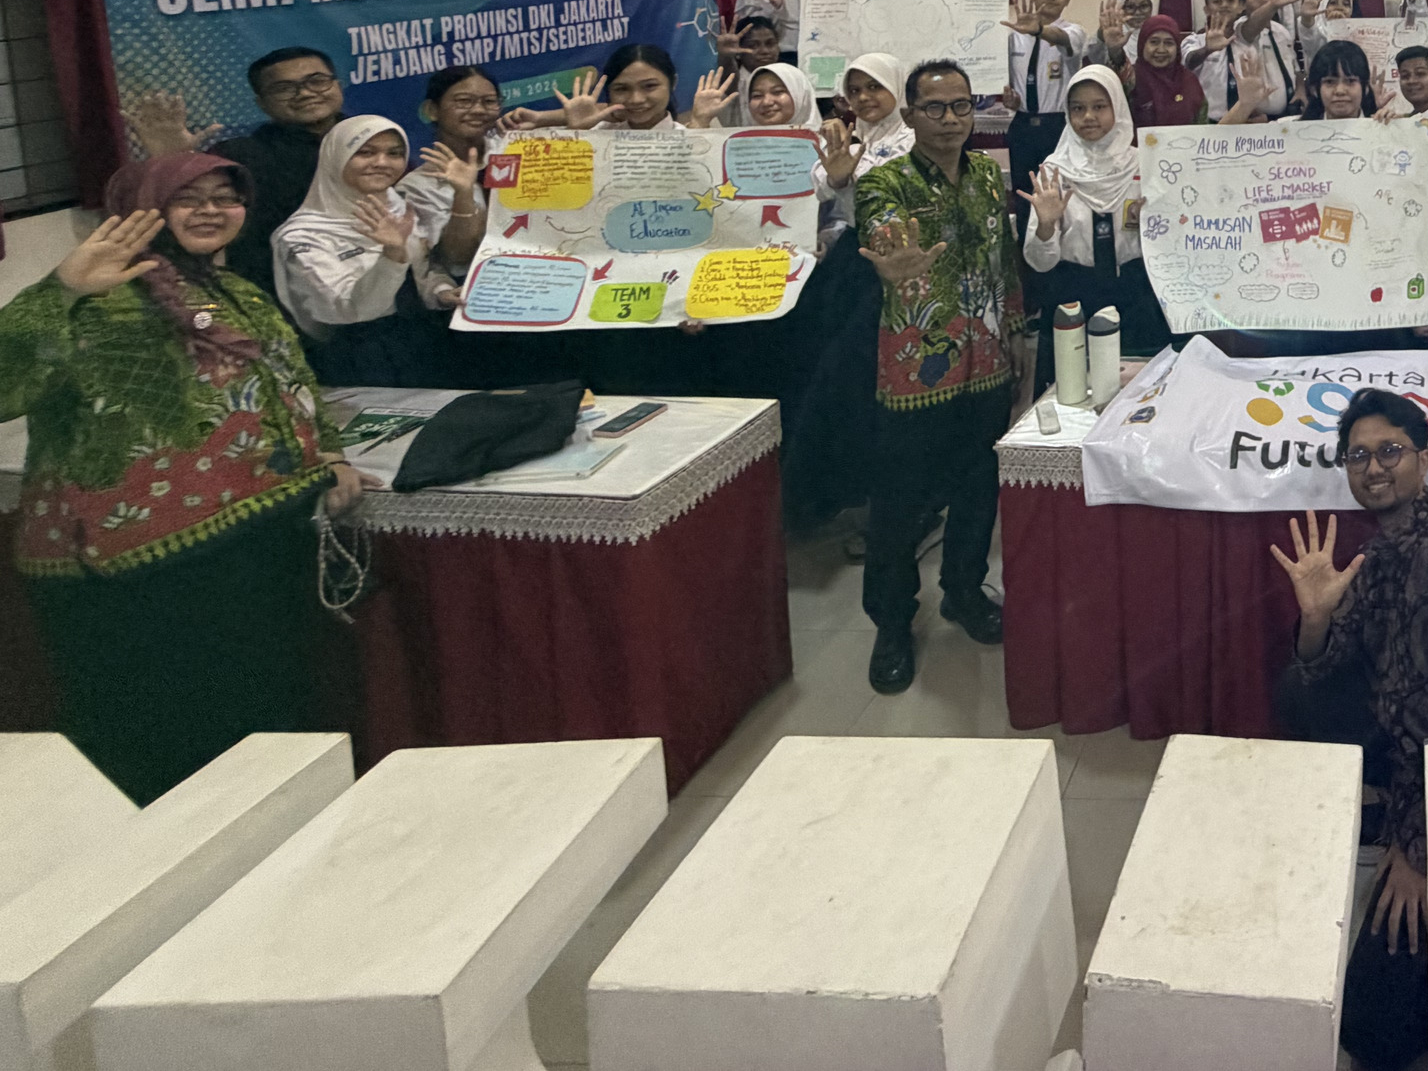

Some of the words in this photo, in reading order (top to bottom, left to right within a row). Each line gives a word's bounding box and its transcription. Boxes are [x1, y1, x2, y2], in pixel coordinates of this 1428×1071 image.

[347, 18, 433, 55] TINGKAT
[441, 7, 523, 43] PROVINSI
[528, 3, 555, 29] DKI
[350, 44, 447, 84] JENJANG
[453, 17, 630, 66] SMP/MTS/SEDERAJAT
[1197, 137, 1229, 155] ALUR
[1235, 135, 1285, 153] Kegiatan
[1268, 167, 1317, 181] SECOND
[1244, 184, 1274, 200] LIFE
[1282, 181, 1333, 194] MARKET
[629, 219, 691, 240] Education
[1193, 214, 1252, 233] RUMUSAN
[1185, 234, 1242, 250] MASALAH
[611, 286, 651, 302] TEAM
[617, 303, 632, 319] 3
